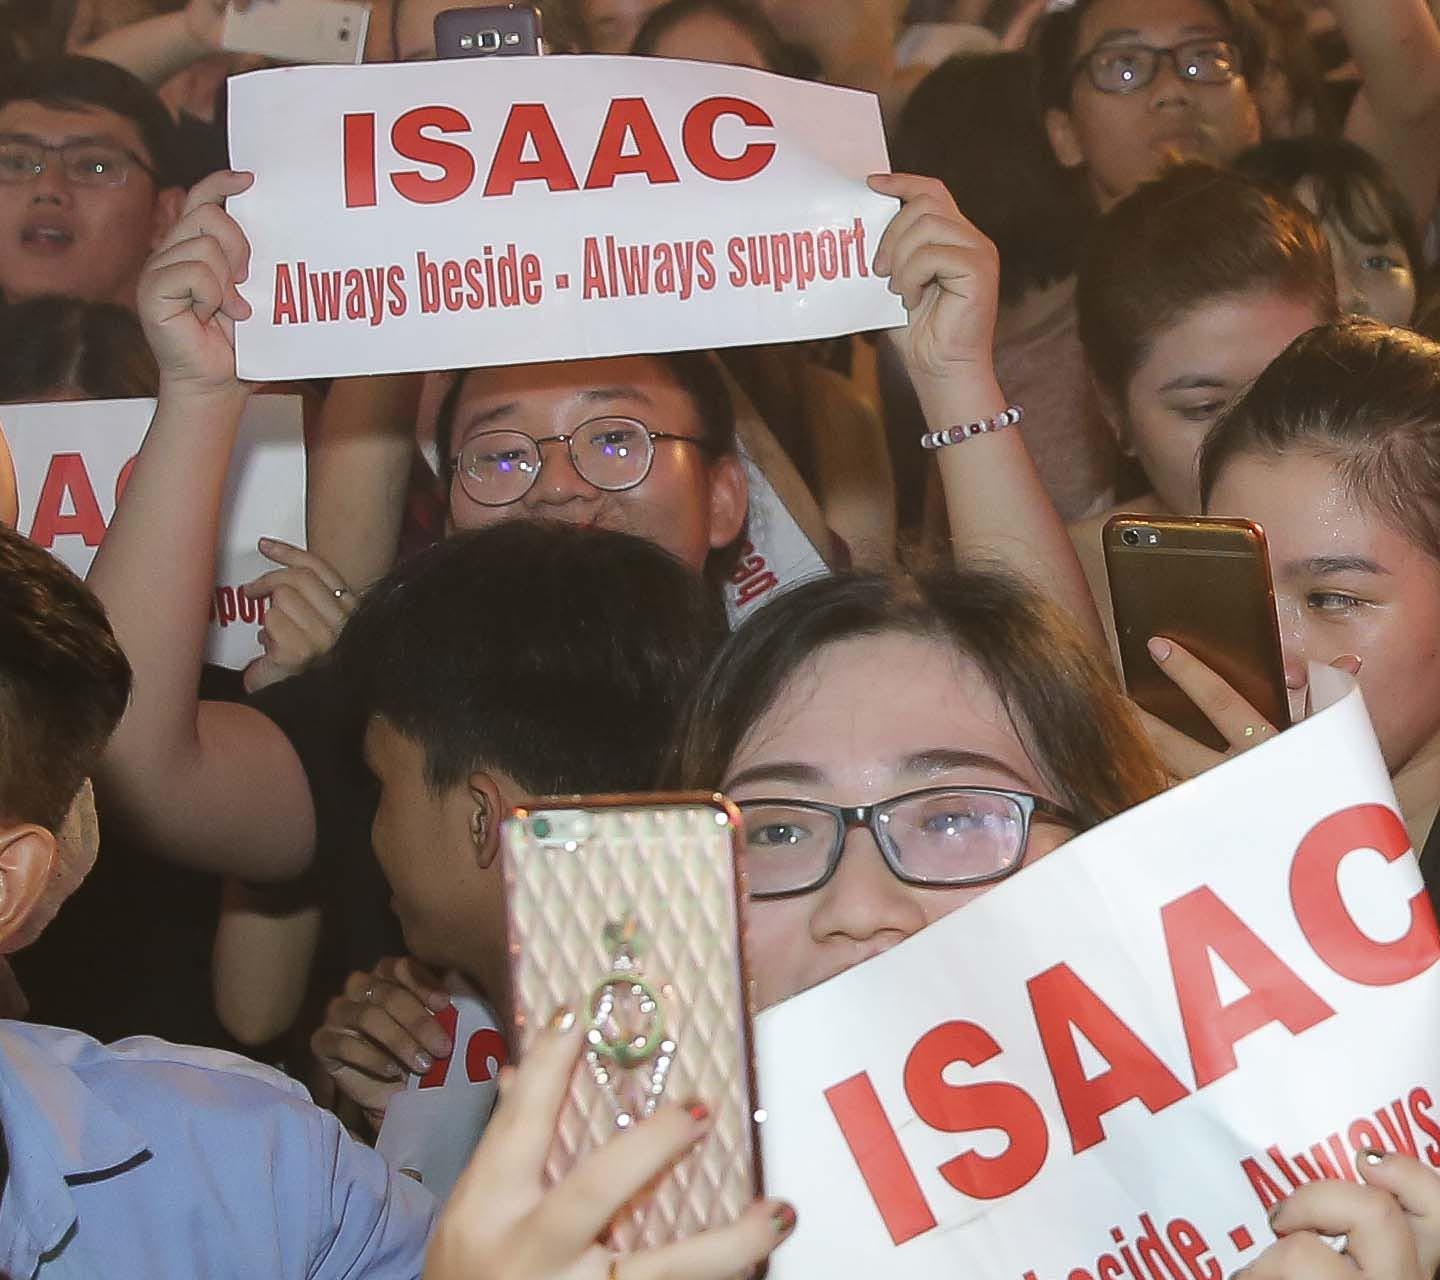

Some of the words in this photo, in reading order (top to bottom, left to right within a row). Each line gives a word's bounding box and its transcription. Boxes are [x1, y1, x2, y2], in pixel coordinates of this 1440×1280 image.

[343, 96, 777, 210] ISAAC
[273, 261, 408, 326] Always
[417, 244, 543, 314] beside
[583, 235, 717, 300] Always
[728, 217, 869, 291] support
